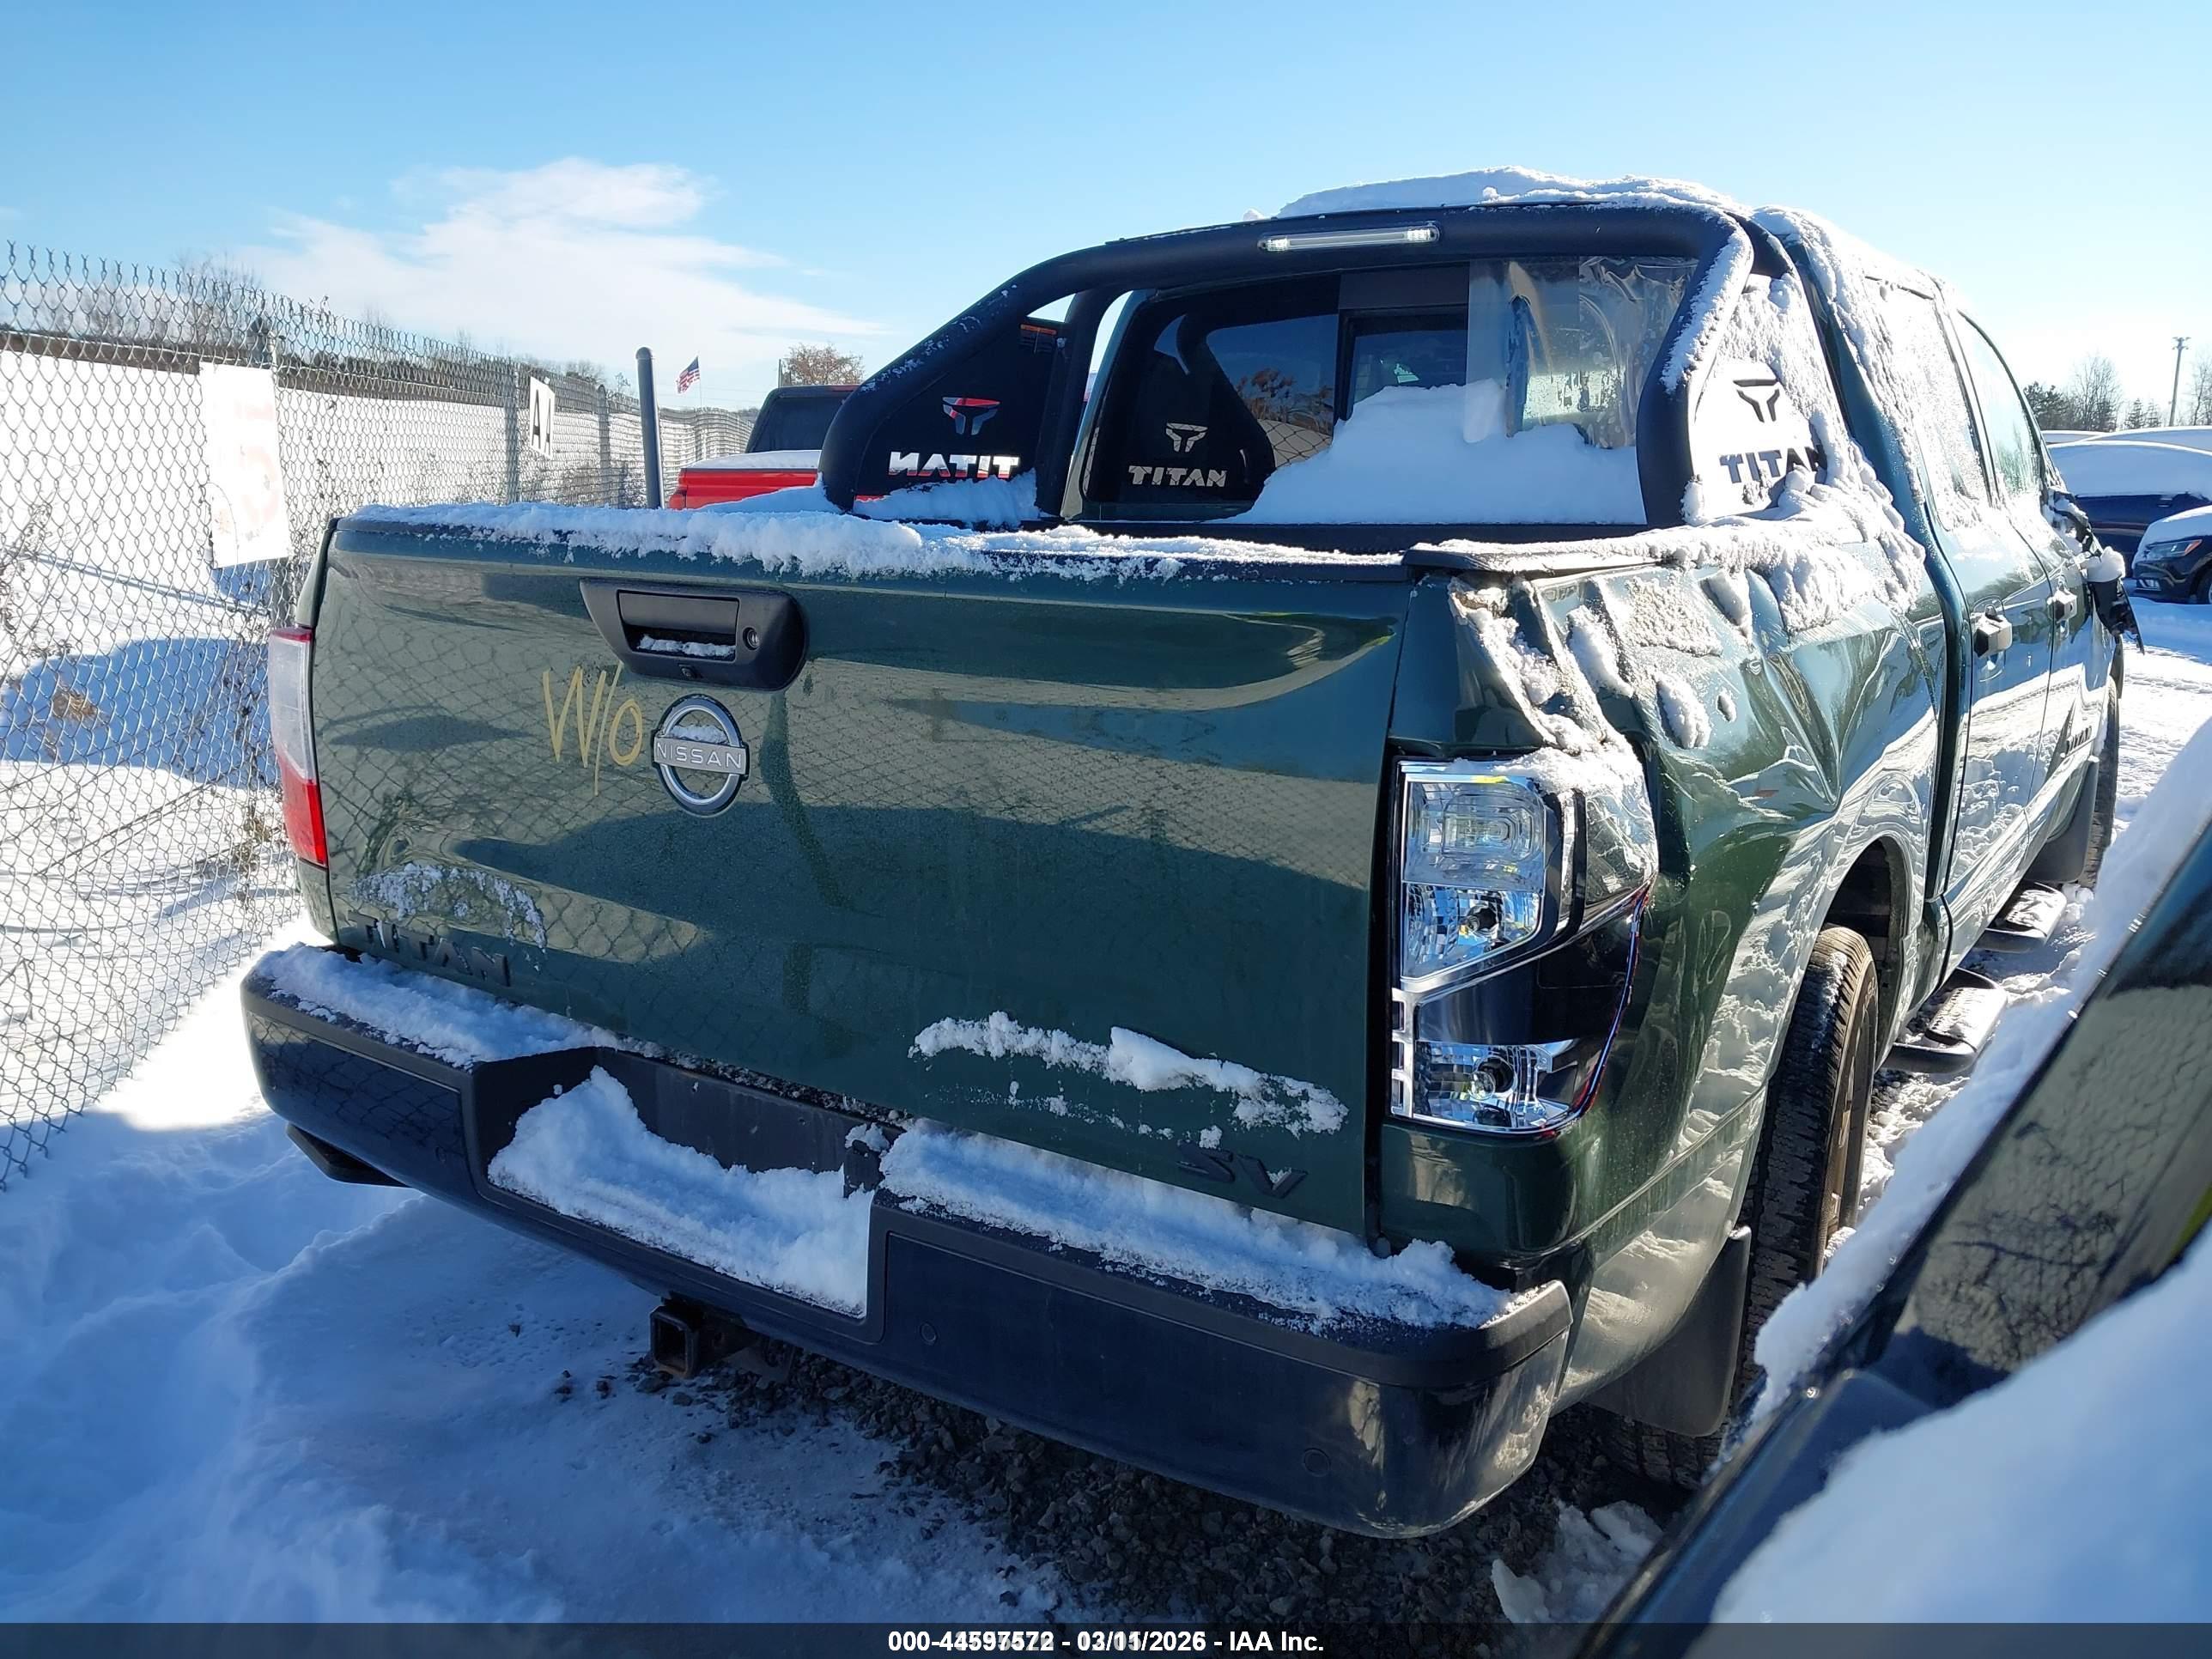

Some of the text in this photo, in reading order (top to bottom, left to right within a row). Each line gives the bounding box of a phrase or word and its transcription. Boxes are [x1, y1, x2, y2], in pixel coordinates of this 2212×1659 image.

[1128, 465, 1228, 488] TITAN
[1719, 445, 1828, 484] TITAN
[655, 740, 743, 770] NISSAN
[1176, 1139, 1309, 1199] SV
